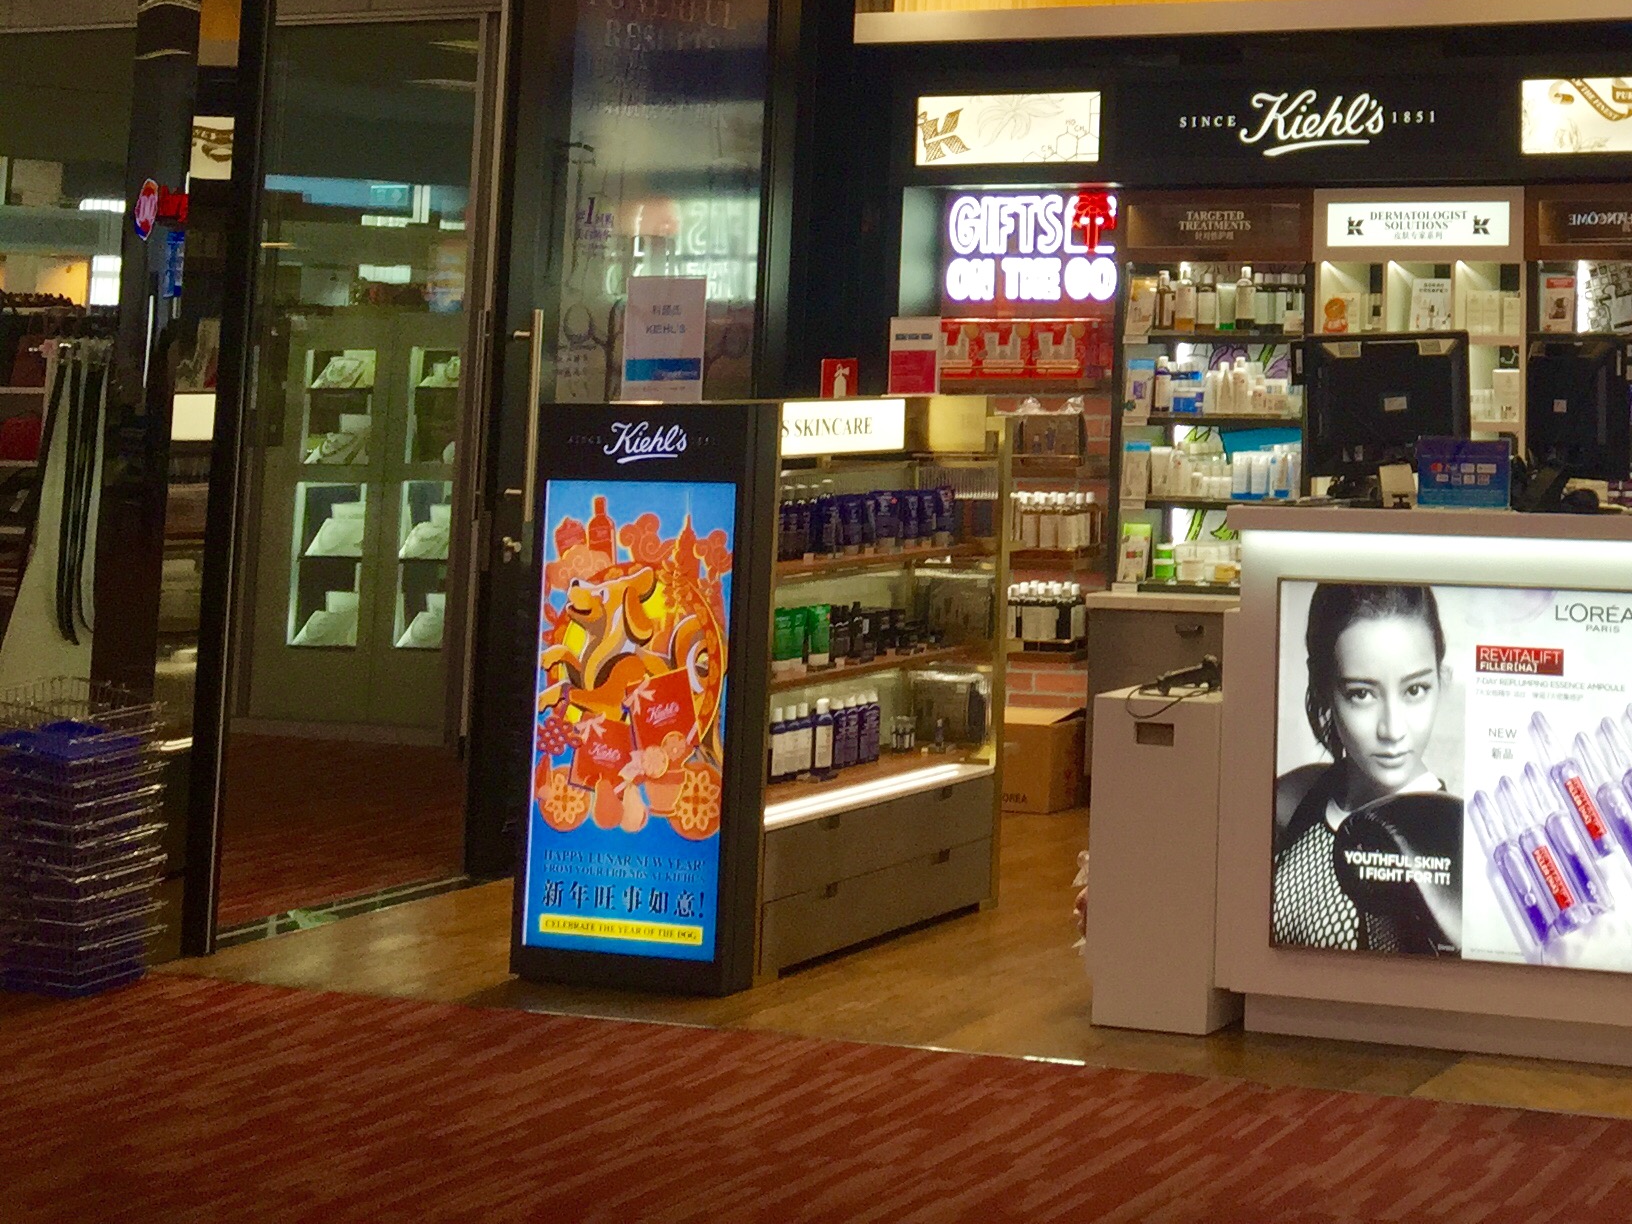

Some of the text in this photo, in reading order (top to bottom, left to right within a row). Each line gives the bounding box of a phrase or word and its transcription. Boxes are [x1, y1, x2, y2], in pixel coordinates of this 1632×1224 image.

[1179, 88, 1437, 146] SINCE Kiehl's 1851
[1186, 210, 1245, 221] TARGETED
[1369, 210, 1468, 221] DERMATOLOGIST
[1178, 220, 1252, 231] TREATMENTS
[794, 416, 873, 438] SKINCARE
[603, 420, 688, 456] Kiehl's
[1585, 624, 1621, 634] PARIS
[1479, 647, 1562, 665] REVITALIFT
[1550, 680, 1585, 690] ESSENCE
[1586, 682, 1626, 693] AMPOULE
[1488, 727, 1518, 739] NEW
[543, 849, 584, 864] HAPPY
[588, 852, 632, 868] LUNAR
[636, 855, 662, 868] NEW
[1344, 850, 1451, 871] YOUTHFUL SKIN?
[543, 863, 573, 874] FROM
[1359, 866, 1451, 886] I FIGHT FOR IT!
[544, 919, 596, 932] CELEBRATE
[599, 923, 615, 933] THE
[618, 925, 641, 935] YEAR
[643, 927, 655, 936] OF
[657, 928, 674, 939] THE
